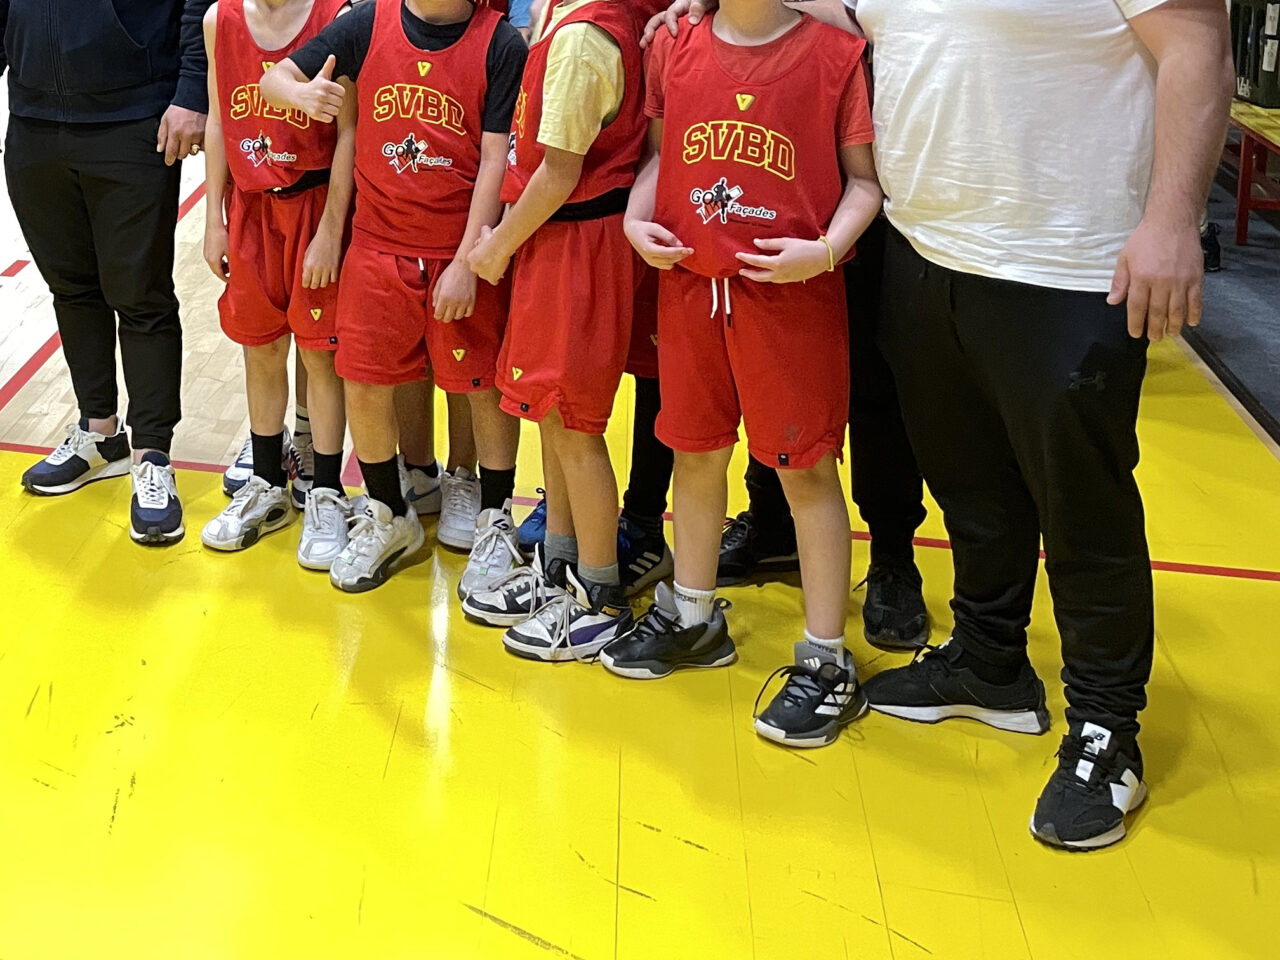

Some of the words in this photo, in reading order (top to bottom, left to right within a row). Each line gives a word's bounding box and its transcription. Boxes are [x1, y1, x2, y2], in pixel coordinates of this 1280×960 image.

[373, 83, 467, 136] SVBD
[418, 154, 453, 168] Façades
[682, 119, 796, 181] SVBD
[728, 201, 777, 221] Façades
